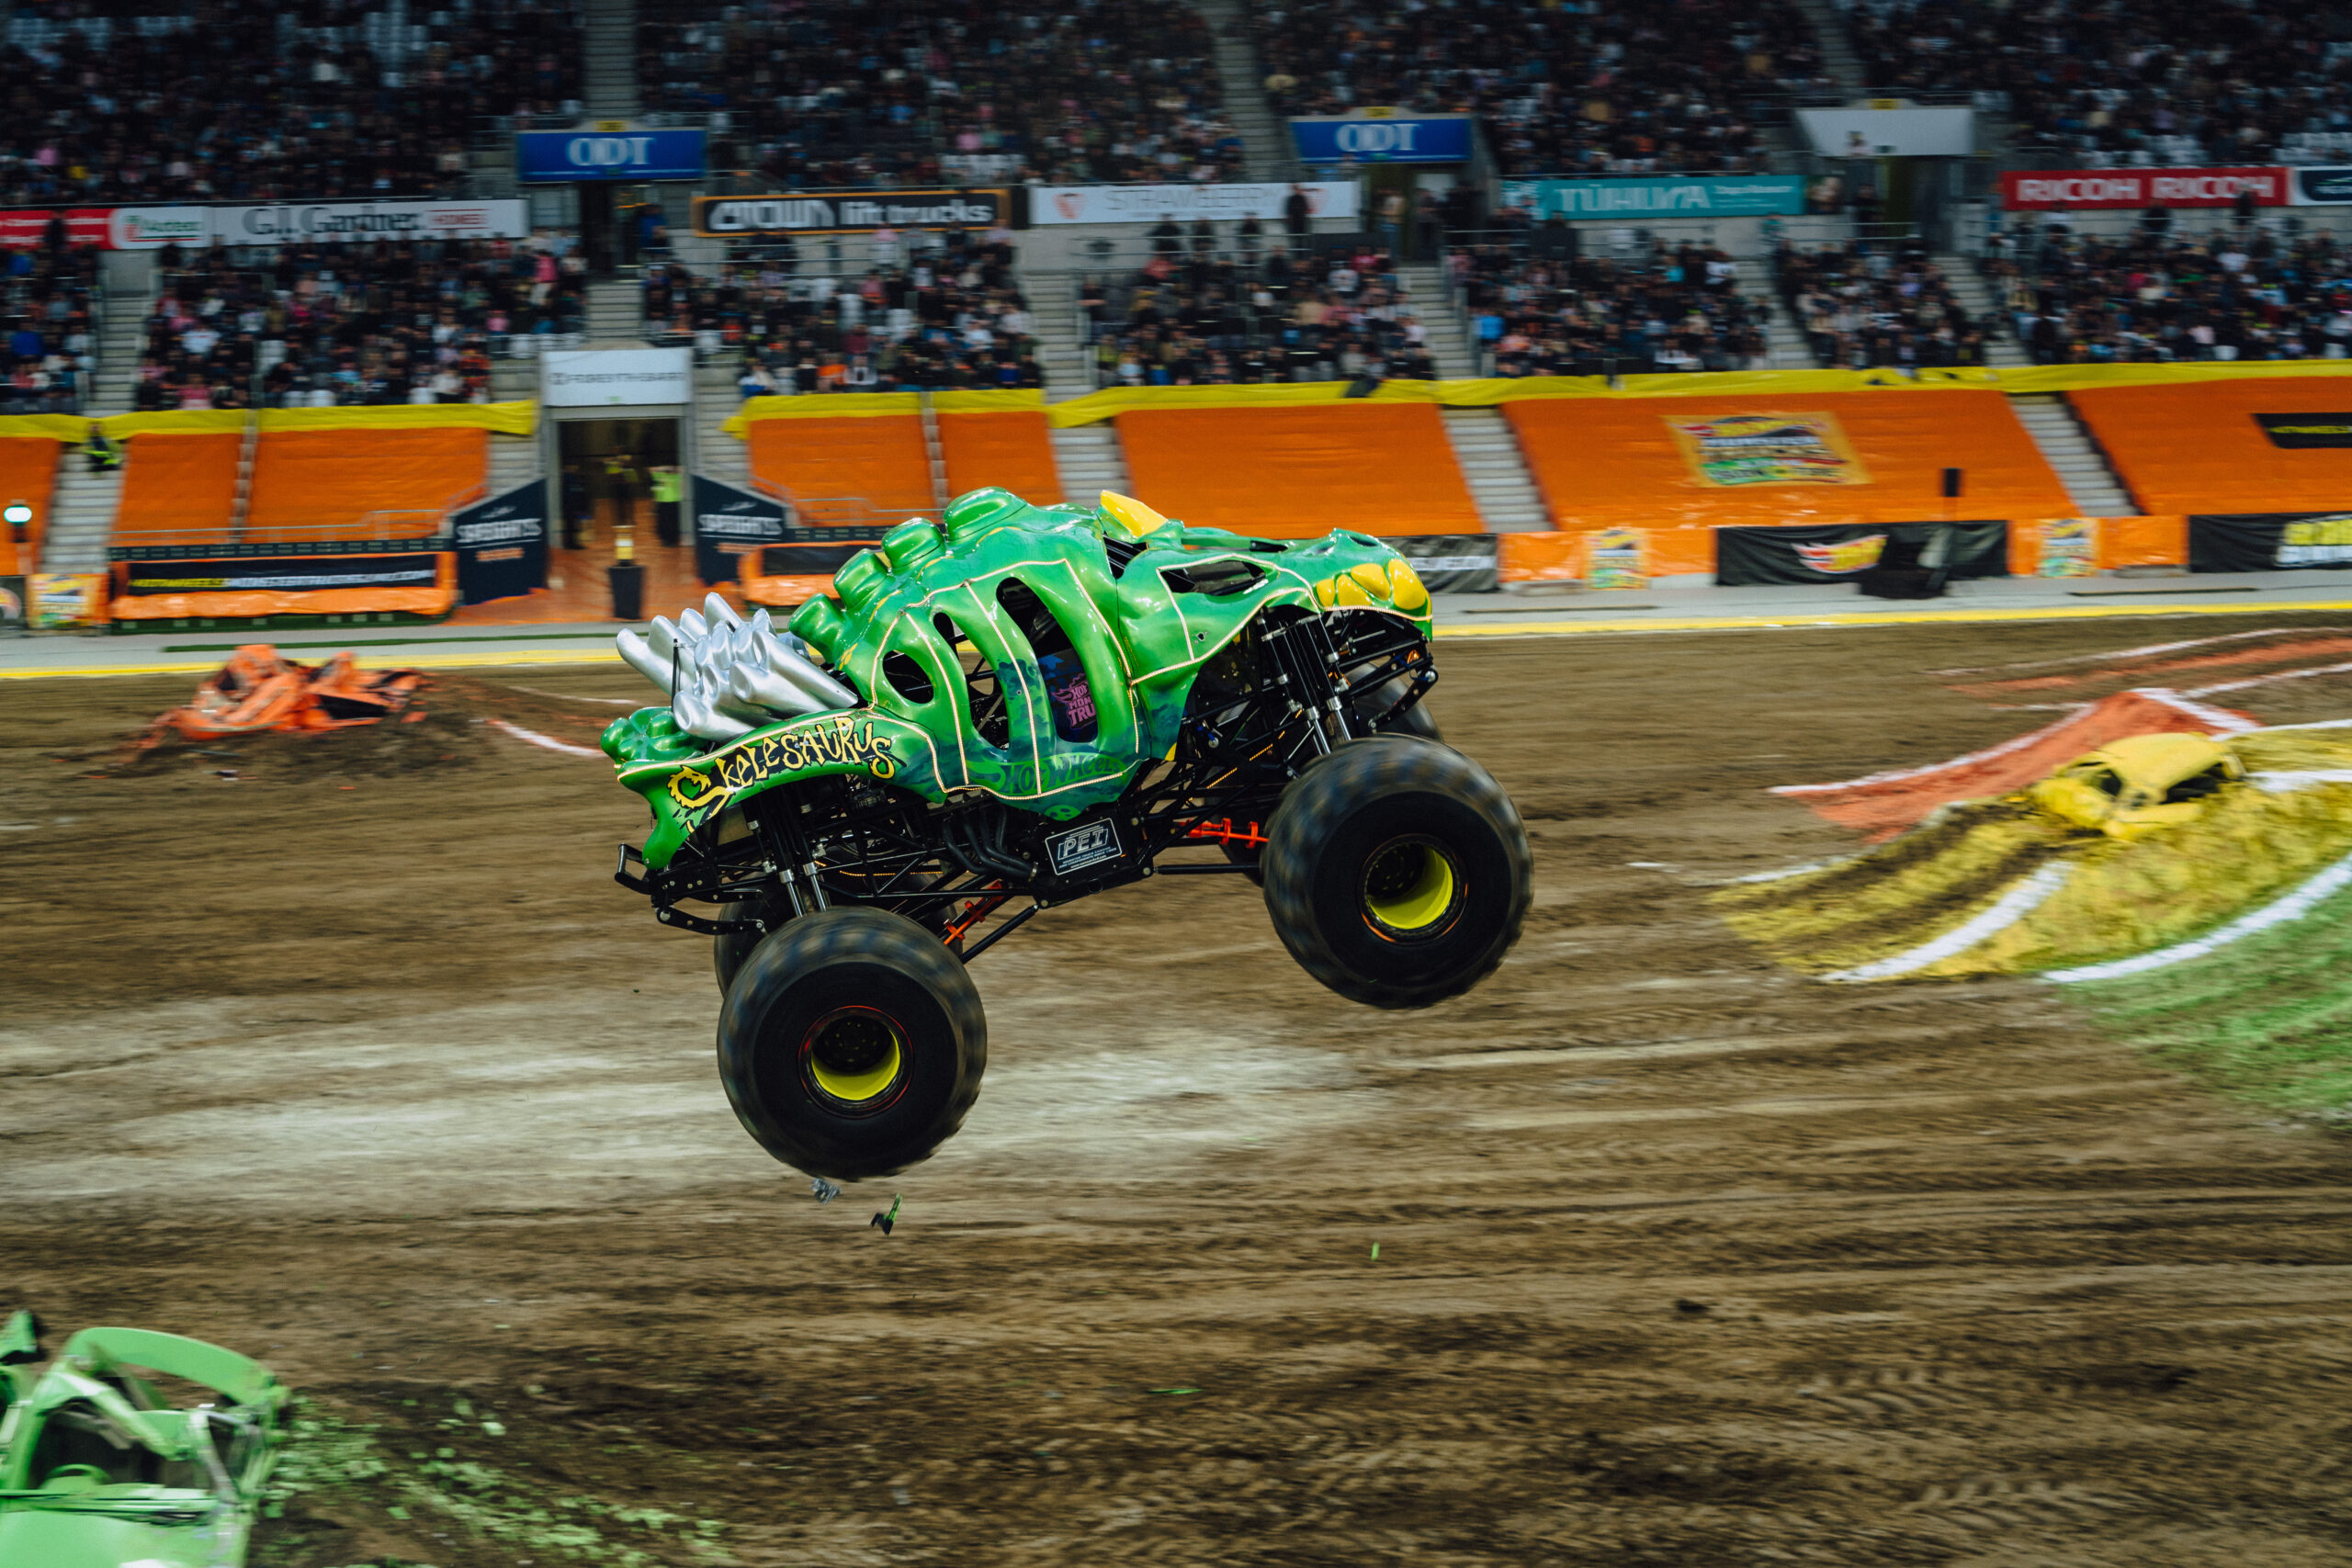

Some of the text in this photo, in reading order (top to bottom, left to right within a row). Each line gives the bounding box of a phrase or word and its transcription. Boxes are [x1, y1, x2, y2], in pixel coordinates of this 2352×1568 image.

[1335, 123, 1421, 152] ODT
[566, 137, 656, 166] ODT
[2017, 177, 2142, 201] RICOH
[2152, 175, 2275, 198] RICOH
[1068, 704, 1096, 726] TRU
[1069, 696, 1092, 710] MON
[1063, 828, 1104, 857] PEI
